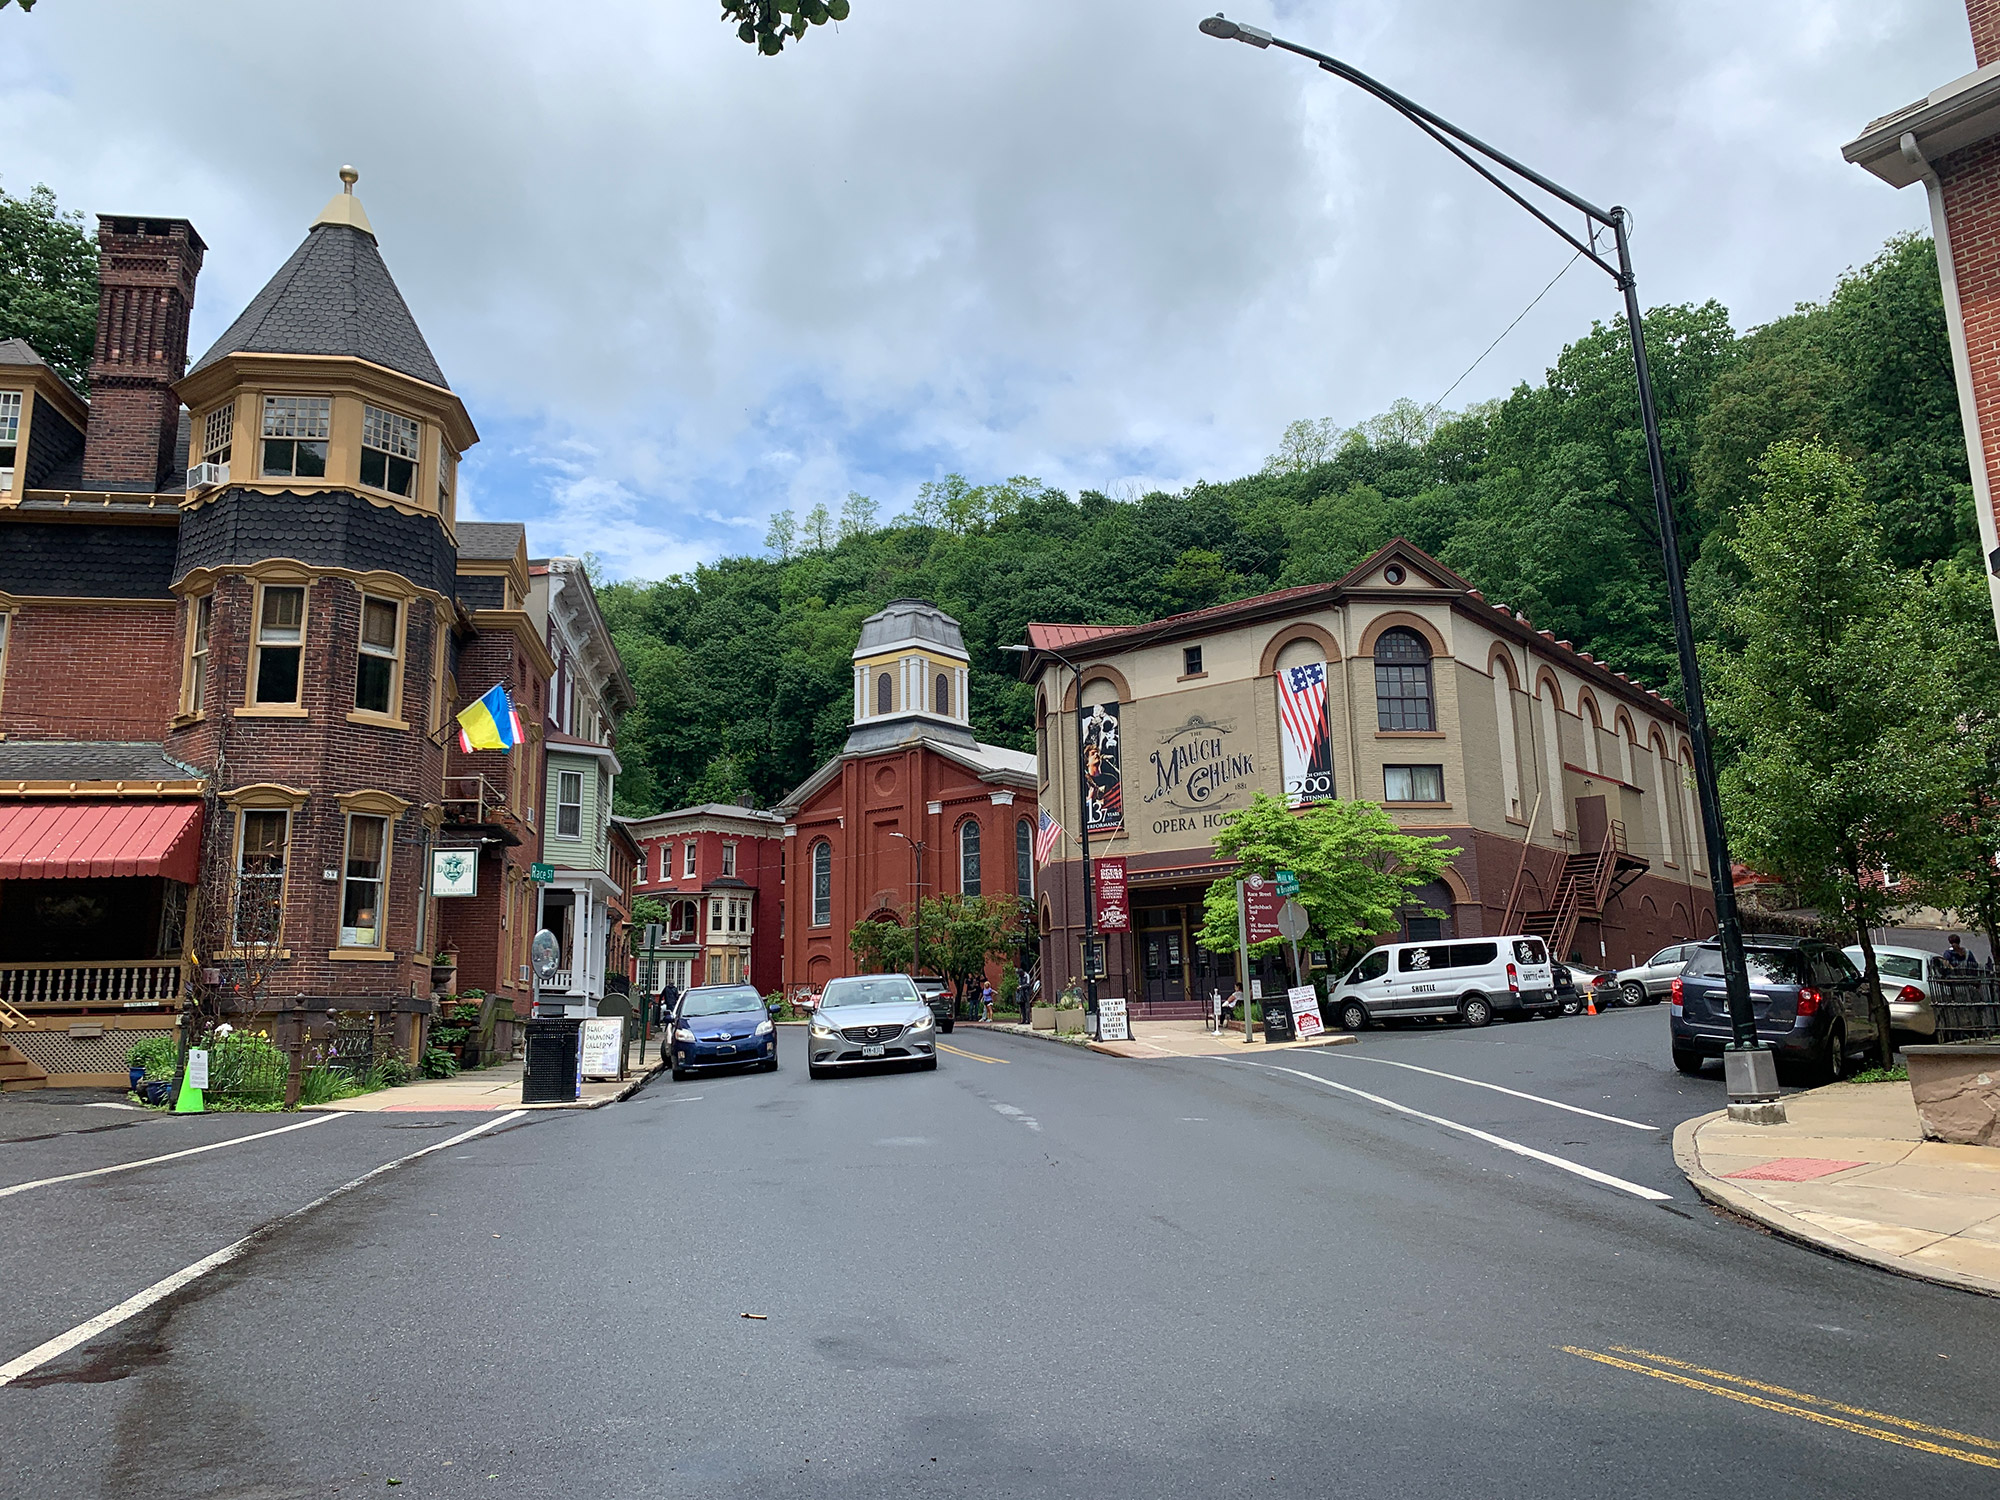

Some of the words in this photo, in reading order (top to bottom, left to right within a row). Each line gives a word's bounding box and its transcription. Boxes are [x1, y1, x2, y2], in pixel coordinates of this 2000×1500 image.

[1190, 730, 1202, 738] THE
[1143, 738, 1222, 803] MAUCH
[1186, 751, 1255, 803] CHUNK
[1288, 776, 1331, 796] 200
[1086, 798, 1108, 824] 137
[1152, 816, 1197, 835] OPERA
[531, 864, 547, 880] Race
[547, 869, 554, 879] ST
[1411, 983, 1437, 993] SHUTTLE
